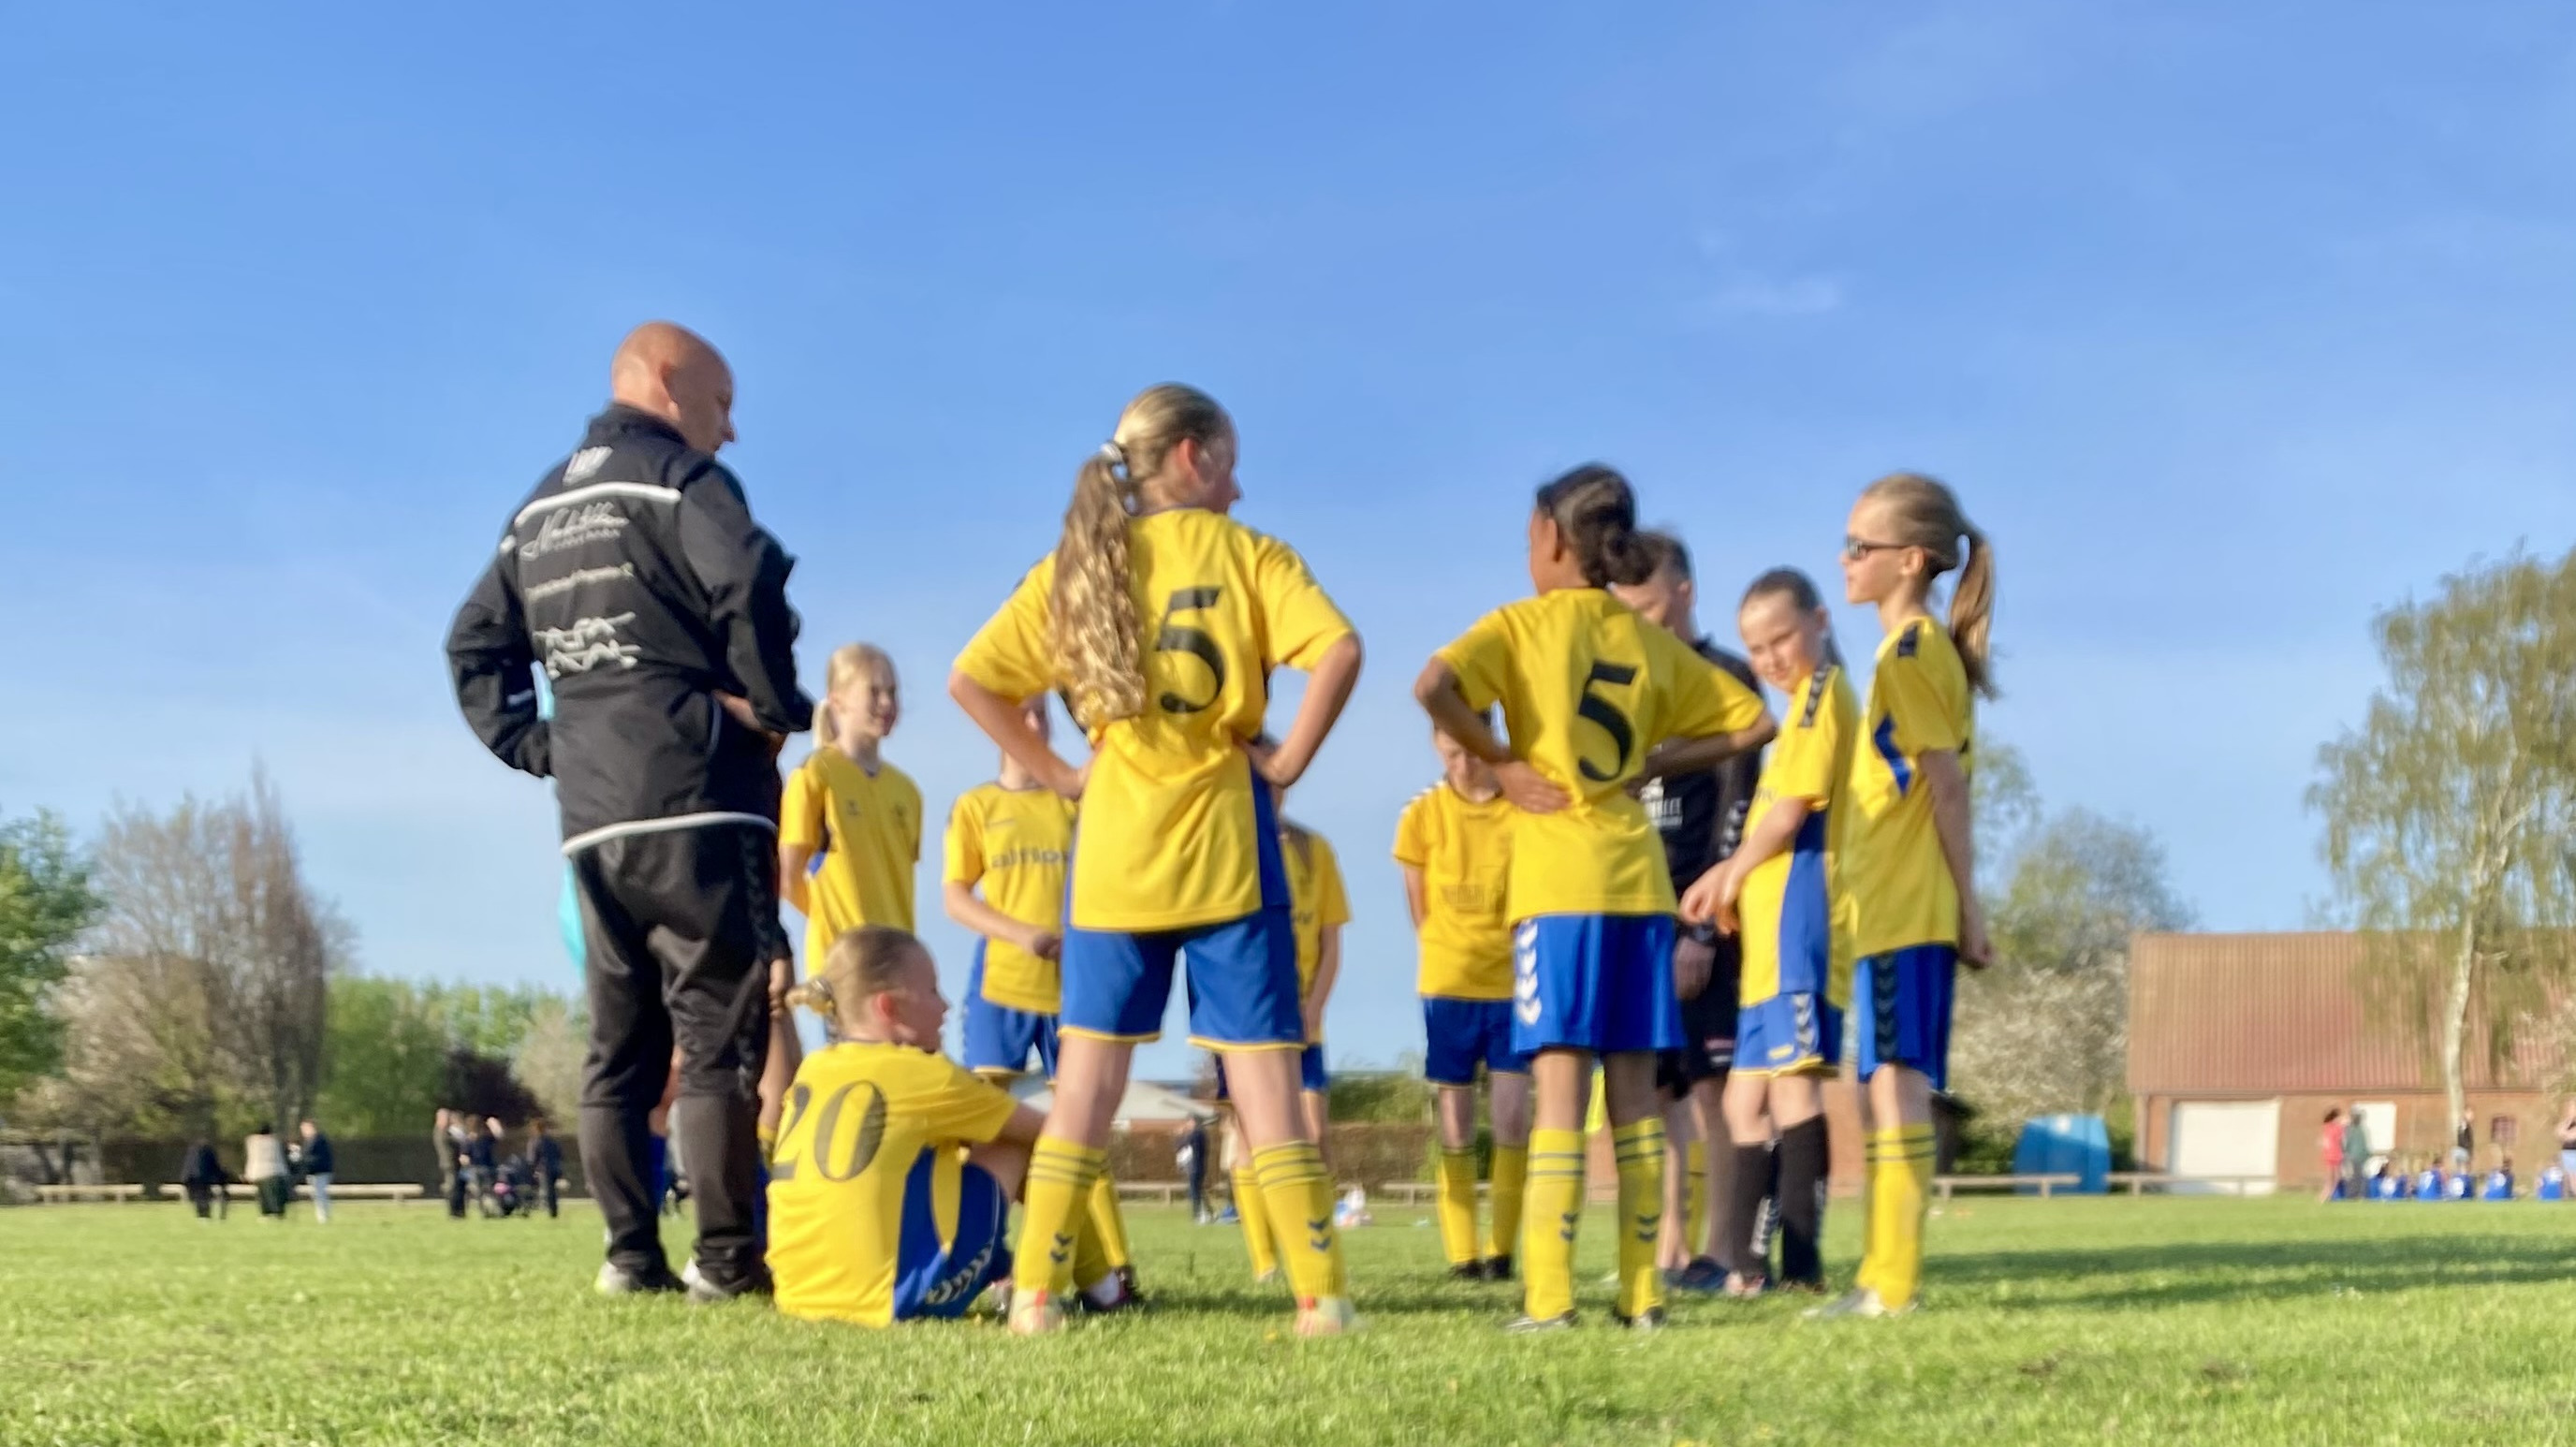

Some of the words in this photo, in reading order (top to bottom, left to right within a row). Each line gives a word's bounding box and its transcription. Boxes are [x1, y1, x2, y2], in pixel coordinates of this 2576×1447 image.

[1154, 586, 1226, 714] 5
[1577, 662, 1638, 782] 5
[768, 1079, 888, 1182] 20
